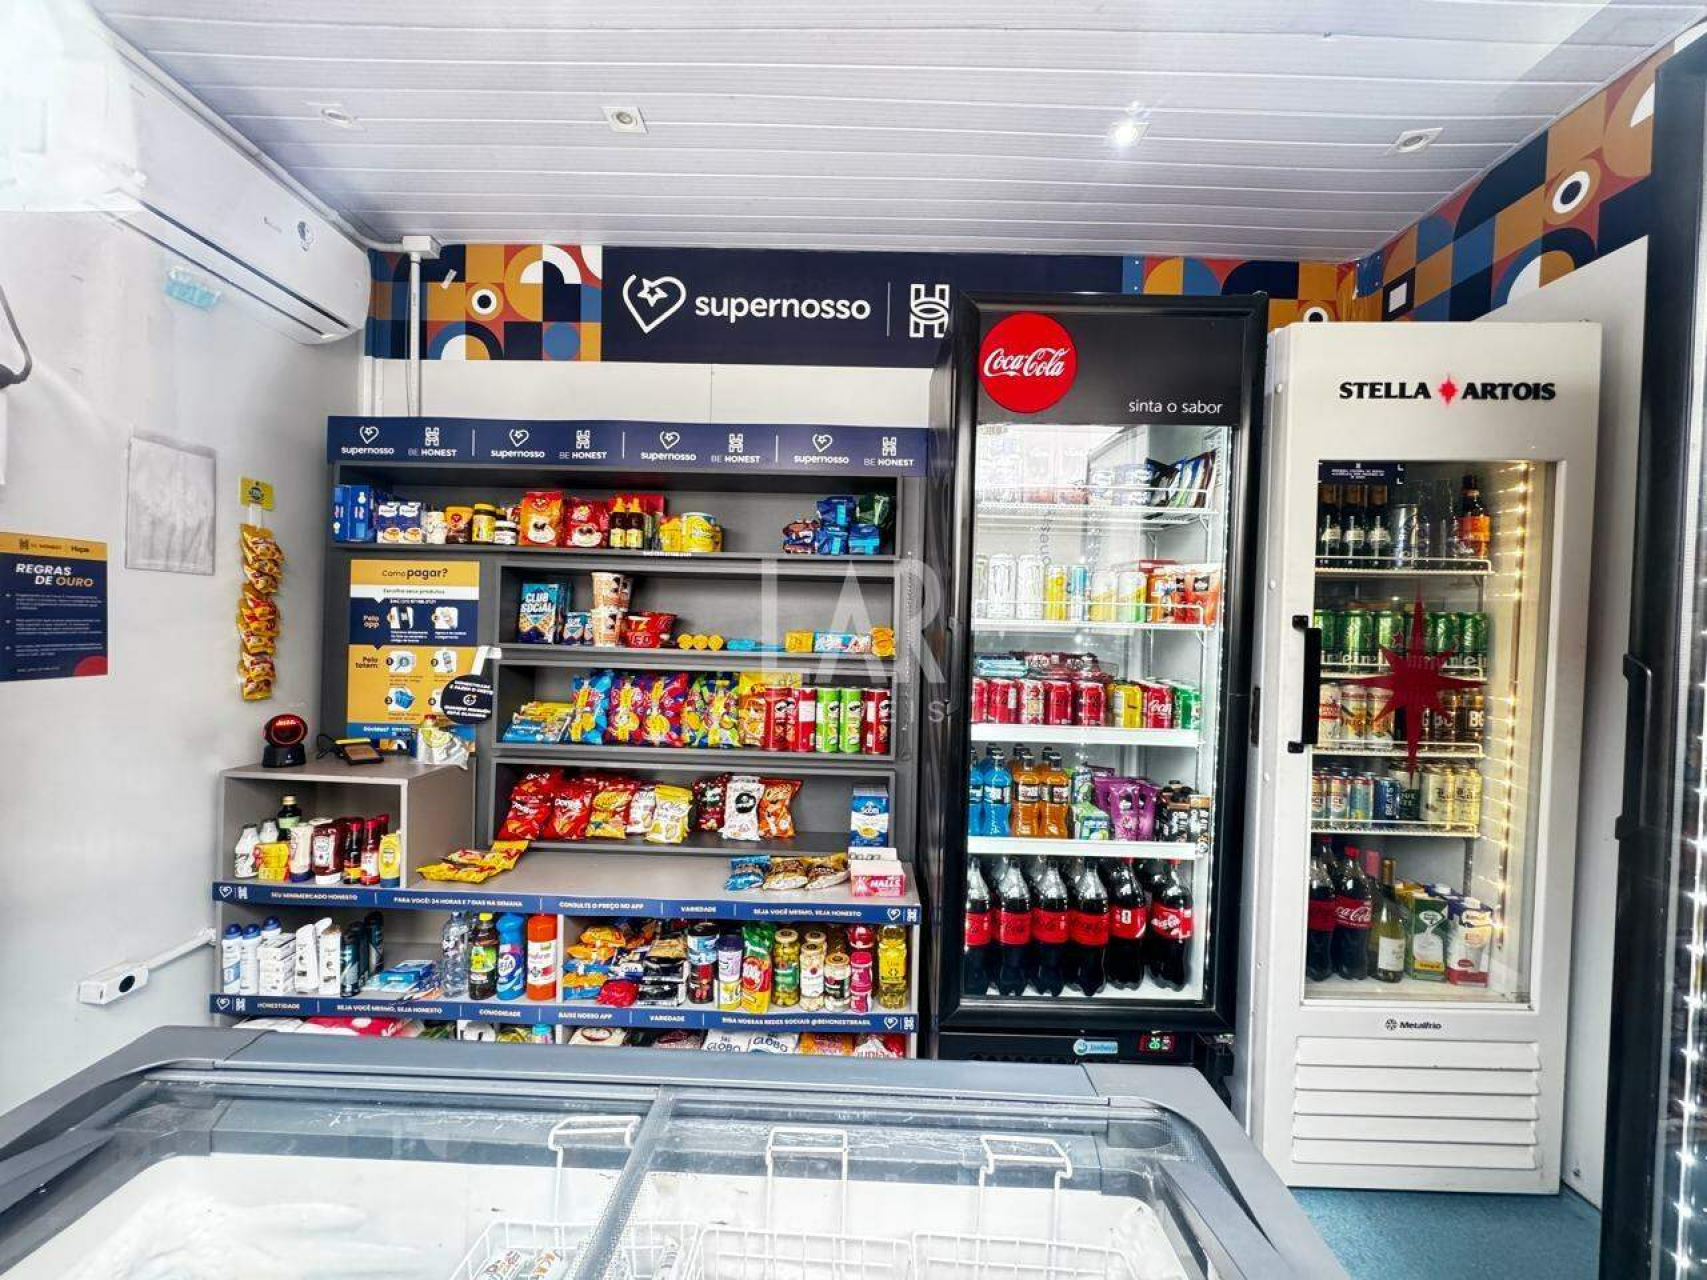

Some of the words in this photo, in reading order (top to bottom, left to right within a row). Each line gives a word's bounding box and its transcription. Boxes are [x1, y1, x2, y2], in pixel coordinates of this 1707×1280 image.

[695, 295, 871, 323] supernosso
[983, 347, 1070, 377] Coca-Cola
[1339, 382, 1431, 399] STELLA
[1462, 382, 1556, 400] ARTOIS
[1128, 399, 1162, 413] sinta
[1167, 403, 1177, 413] o
[1182, 400, 1223, 414] sabor
[340, 446, 395, 456] supernosso
[421, 449, 457, 457] HONEST
[490, 449, 545, 459] supernosso
[559, 452, 571, 460] BE
[571, 452, 608, 460] HONEST
[640, 452, 696, 463] supernosso
[711, 455, 722, 463] BE
[724, 455, 761, 464] HONEST
[794, 454, 850, 465] supernosso
[863, 458, 876, 466] BE
[877, 458, 914, 467] HONEST
[15, 563, 72, 577] REGRAS
[407, 568, 448, 580] pagar?
[34, 575, 53, 586] DE
[56, 576, 94, 588] OURO
[527, 592, 549, 602] CLUB
[521, 602, 553, 613] SOCIAL
[1399, 1020, 1442, 1030] Metalfrio
[753, 1035, 788, 1053] GLOBO
